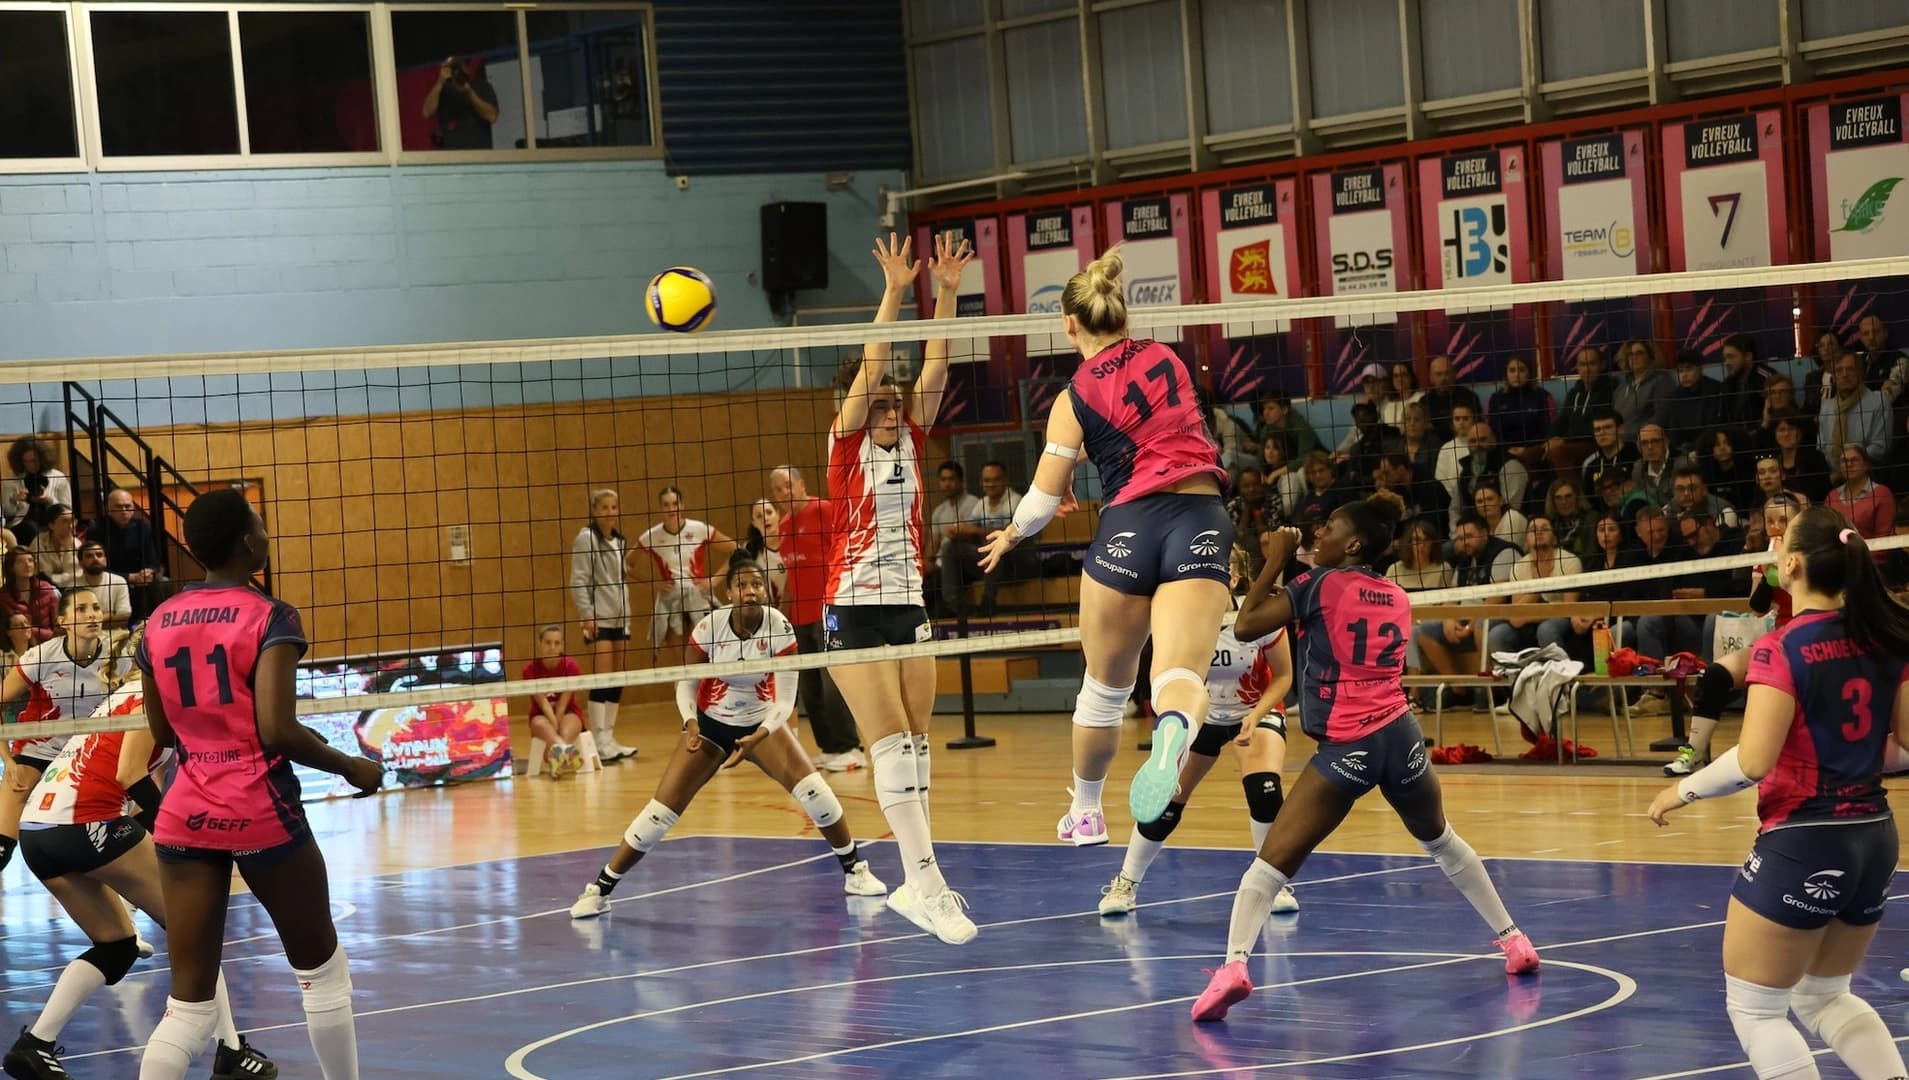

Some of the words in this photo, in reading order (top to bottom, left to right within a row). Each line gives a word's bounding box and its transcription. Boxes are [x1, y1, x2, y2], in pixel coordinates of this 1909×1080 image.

[1846, 104, 1884, 124] EVREUX
[1702, 123, 1740, 143] EVREUX
[1836, 119, 1895, 141] VOLLEYBALL
[1575, 142, 1609, 160] EVREUX
[1691, 137, 1752, 160] VOLLEYBALL
[1455, 158, 1487, 175] EVREUX
[1567, 155, 1620, 176] VOLLEYBALL
[1343, 174, 1372, 191] EVREUX
[1446, 171, 1496, 191] VOLLEYBALL
[1232, 190, 1264, 207] EVREUX
[1335, 187, 1381, 206] VOLLEYBALL
[1133, 204, 1160, 219] EVREUX
[1224, 204, 1273, 222] VOLLEYBALL
[1036, 216, 1062, 231] EVREUX
[1126, 217, 1168, 234] VOLLEYBALL
[1030, 228, 1070, 246] VOLLEYBALL
[1564, 228, 1607, 243] TEAM
[1332, 248, 1393, 275] S.D.S
[1127, 277, 1177, 305] SCOGEX
[1121, 356, 1182, 419] 17
[1095, 555, 1138, 579] Groupama
[1359, 587, 1394, 607] KONE
[161, 606, 240, 629] BLAMDAI
[1346, 617, 1407, 667] 12
[1210, 650, 1231, 667] 20
[164, 644, 234, 708] 11
[1840, 677, 1873, 742] 3
[207, 817, 252, 832] GEFF
